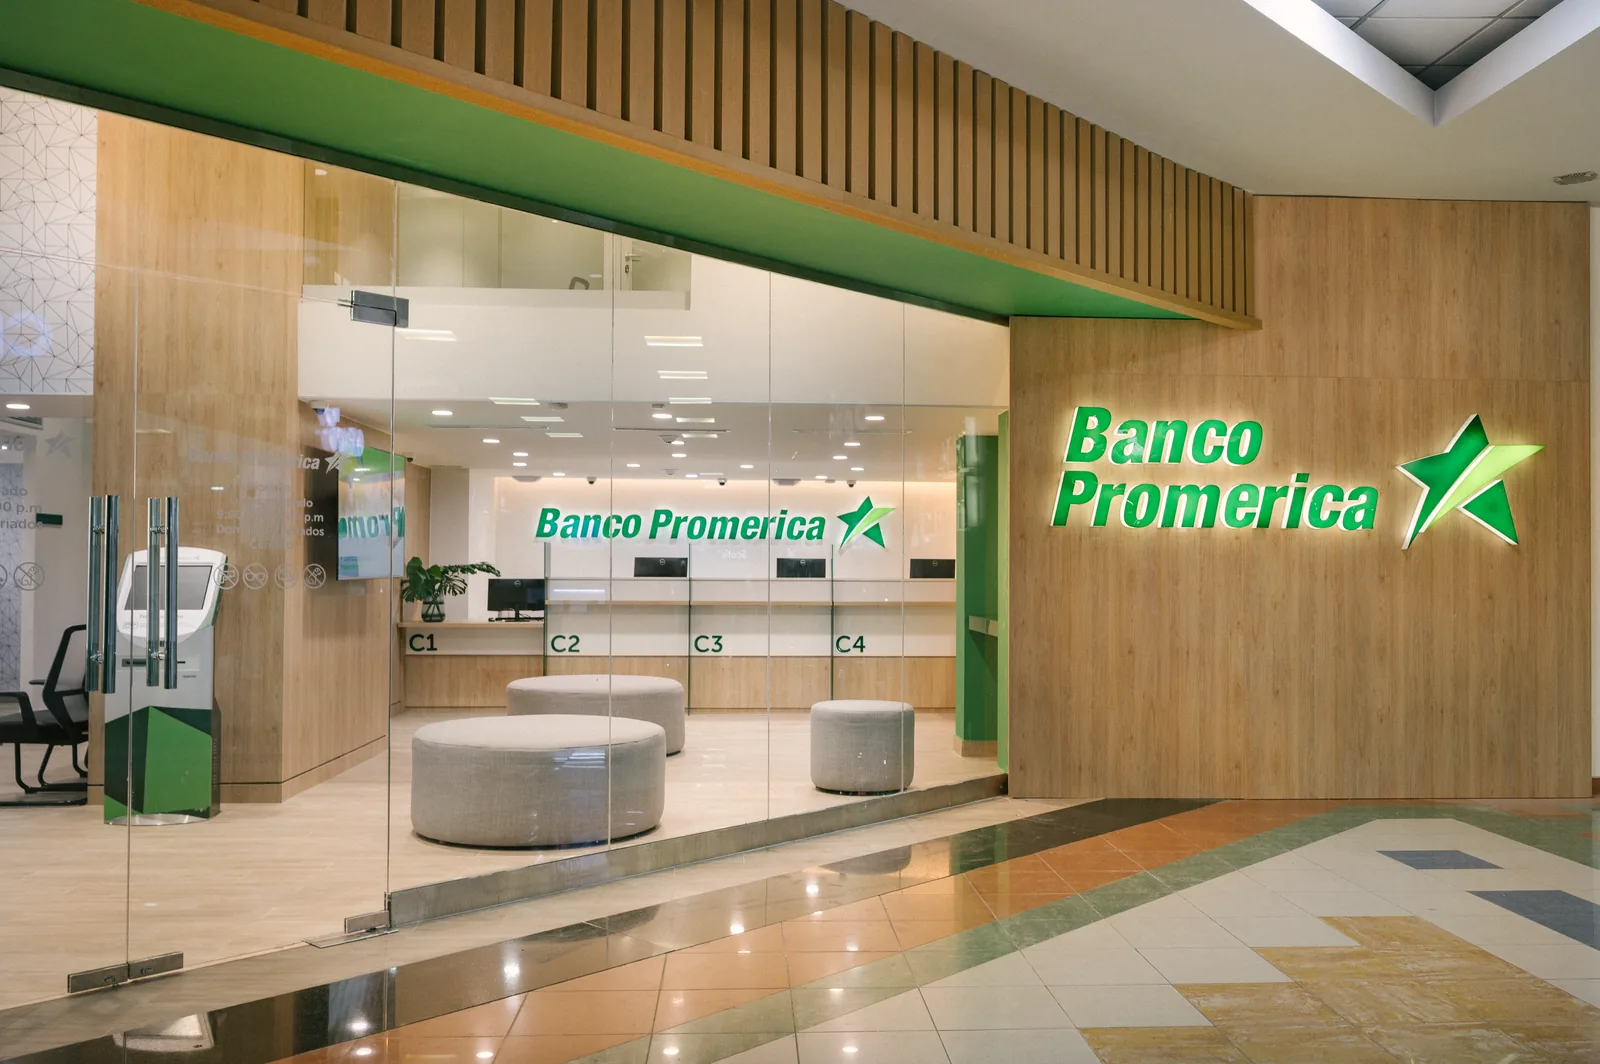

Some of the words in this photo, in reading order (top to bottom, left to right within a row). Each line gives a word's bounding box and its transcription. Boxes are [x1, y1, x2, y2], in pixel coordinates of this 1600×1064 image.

[1064, 406, 1263, 465] Banco
[0, 485, 28, 497] ado
[1050, 470, 1378, 531] Promerica
[304, 513, 324, 524] p.m
[535, 508, 641, 539] Banco
[648, 508, 826, 541] Promerica
[408, 634, 437, 653] C1
[550, 634, 581, 653] C2
[693, 634, 723, 653] C3
[835, 634, 866, 653] C4
